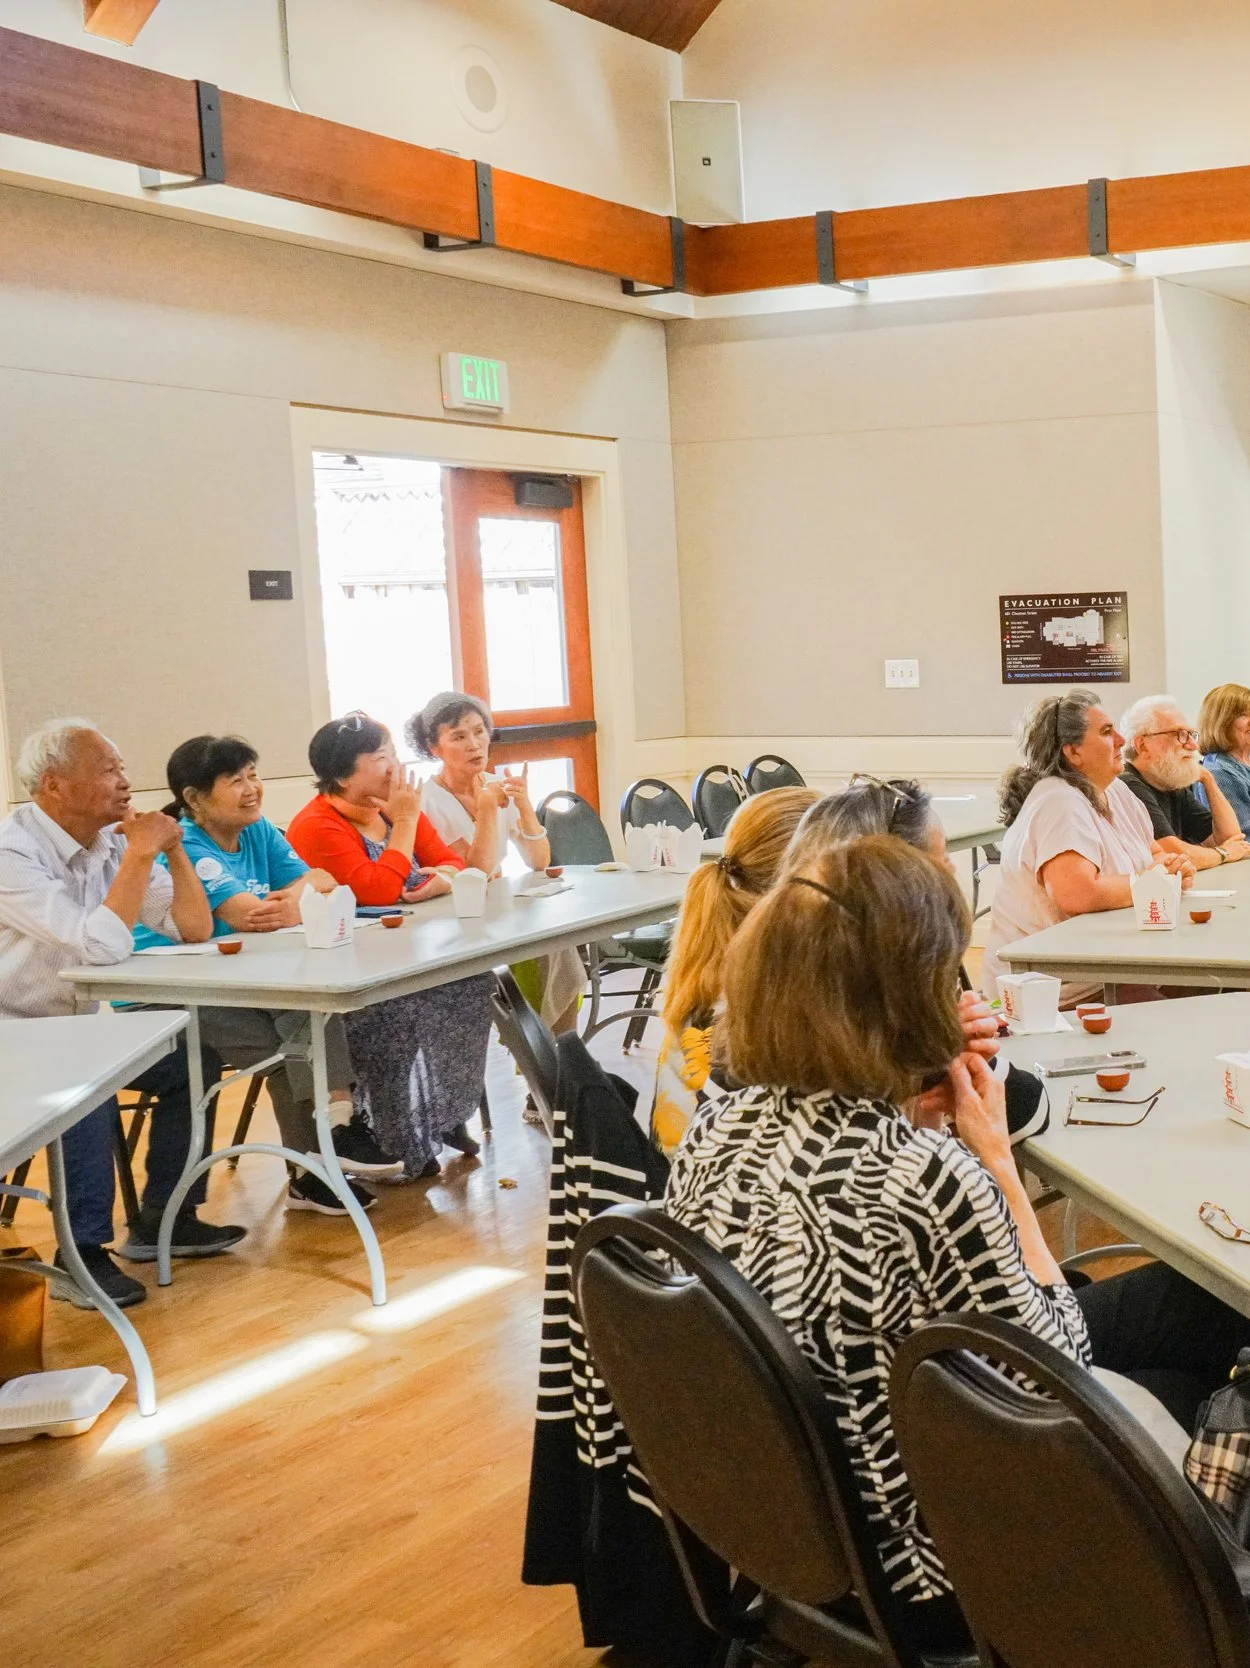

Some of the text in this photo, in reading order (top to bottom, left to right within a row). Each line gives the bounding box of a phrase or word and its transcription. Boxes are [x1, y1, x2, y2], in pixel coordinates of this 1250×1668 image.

[460, 356, 500, 402] EXIT
[1004, 597, 1122, 608] EVACUATION PLAN
